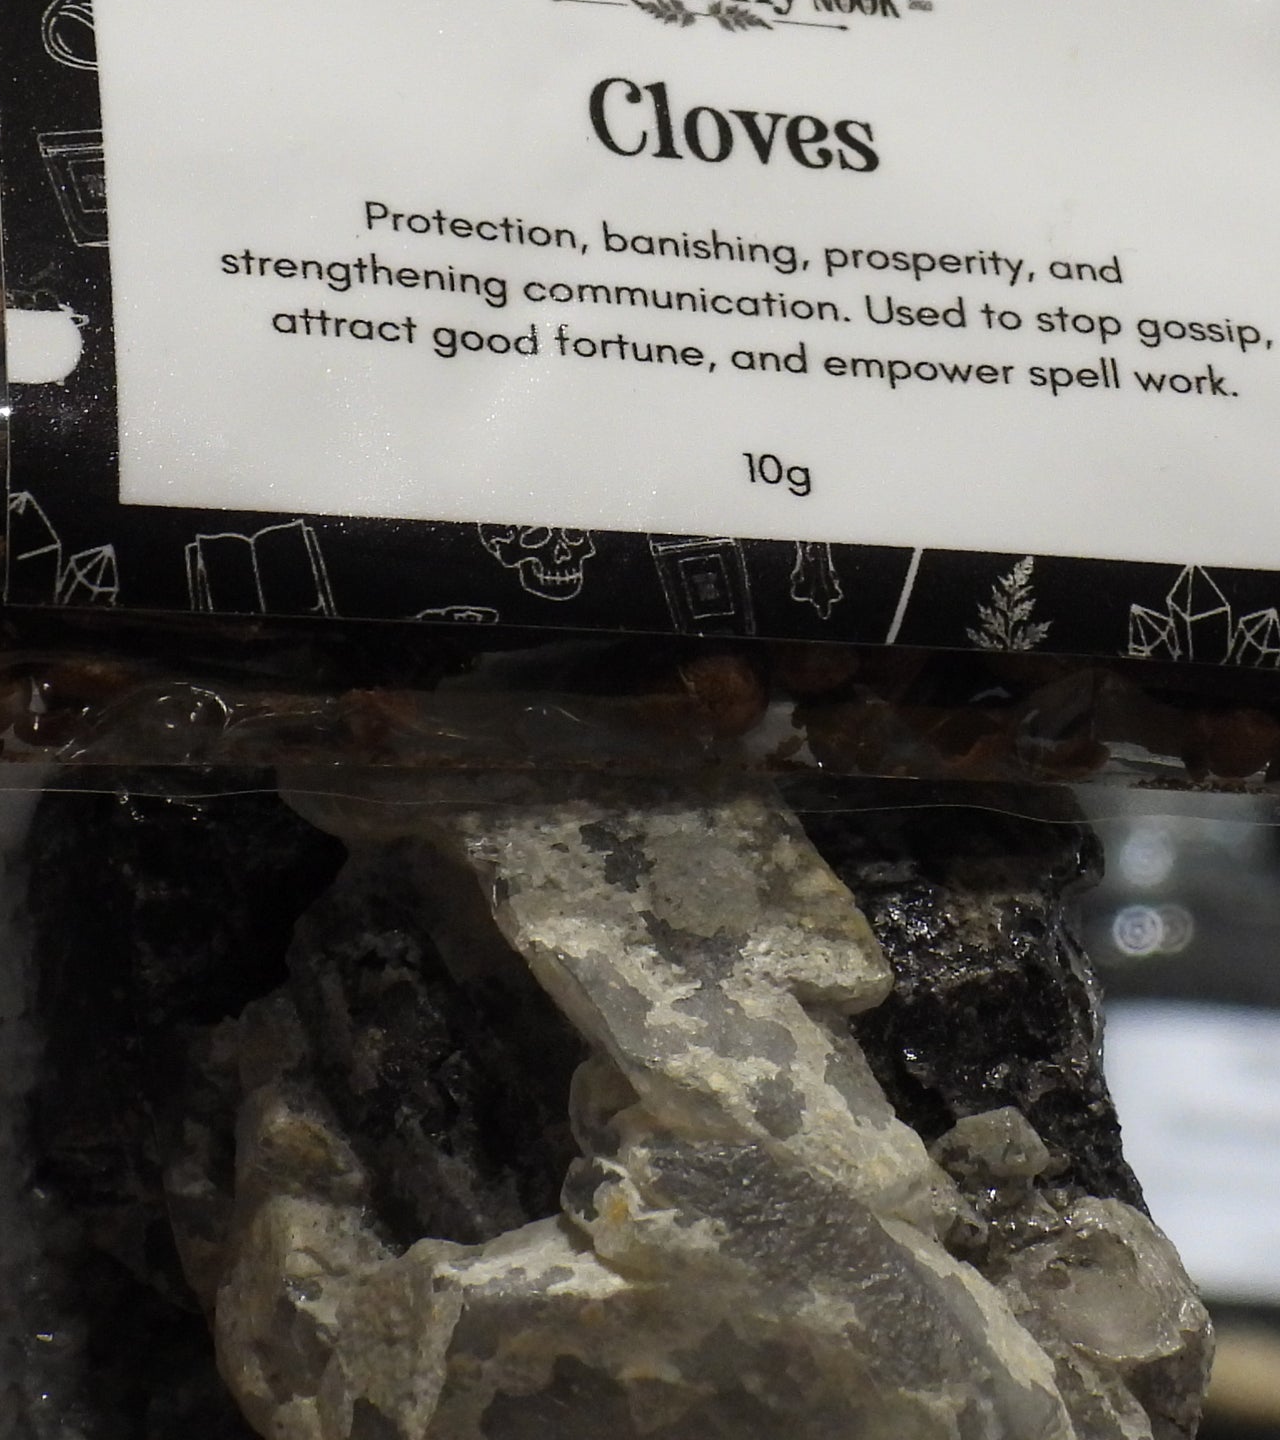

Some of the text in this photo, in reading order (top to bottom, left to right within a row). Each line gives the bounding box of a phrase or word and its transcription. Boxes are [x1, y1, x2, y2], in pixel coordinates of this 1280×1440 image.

[588, 77, 880, 173] Cloves
[364, 200, 1124, 287] Protection, banishing, prosperity, and
[220, 248, 1273, 354] strengthening communication. Used to stop gossip,
[271, 307, 1239, 398] attract good fortune, and empower spell work.
[742, 452, 812, 498] 10g
